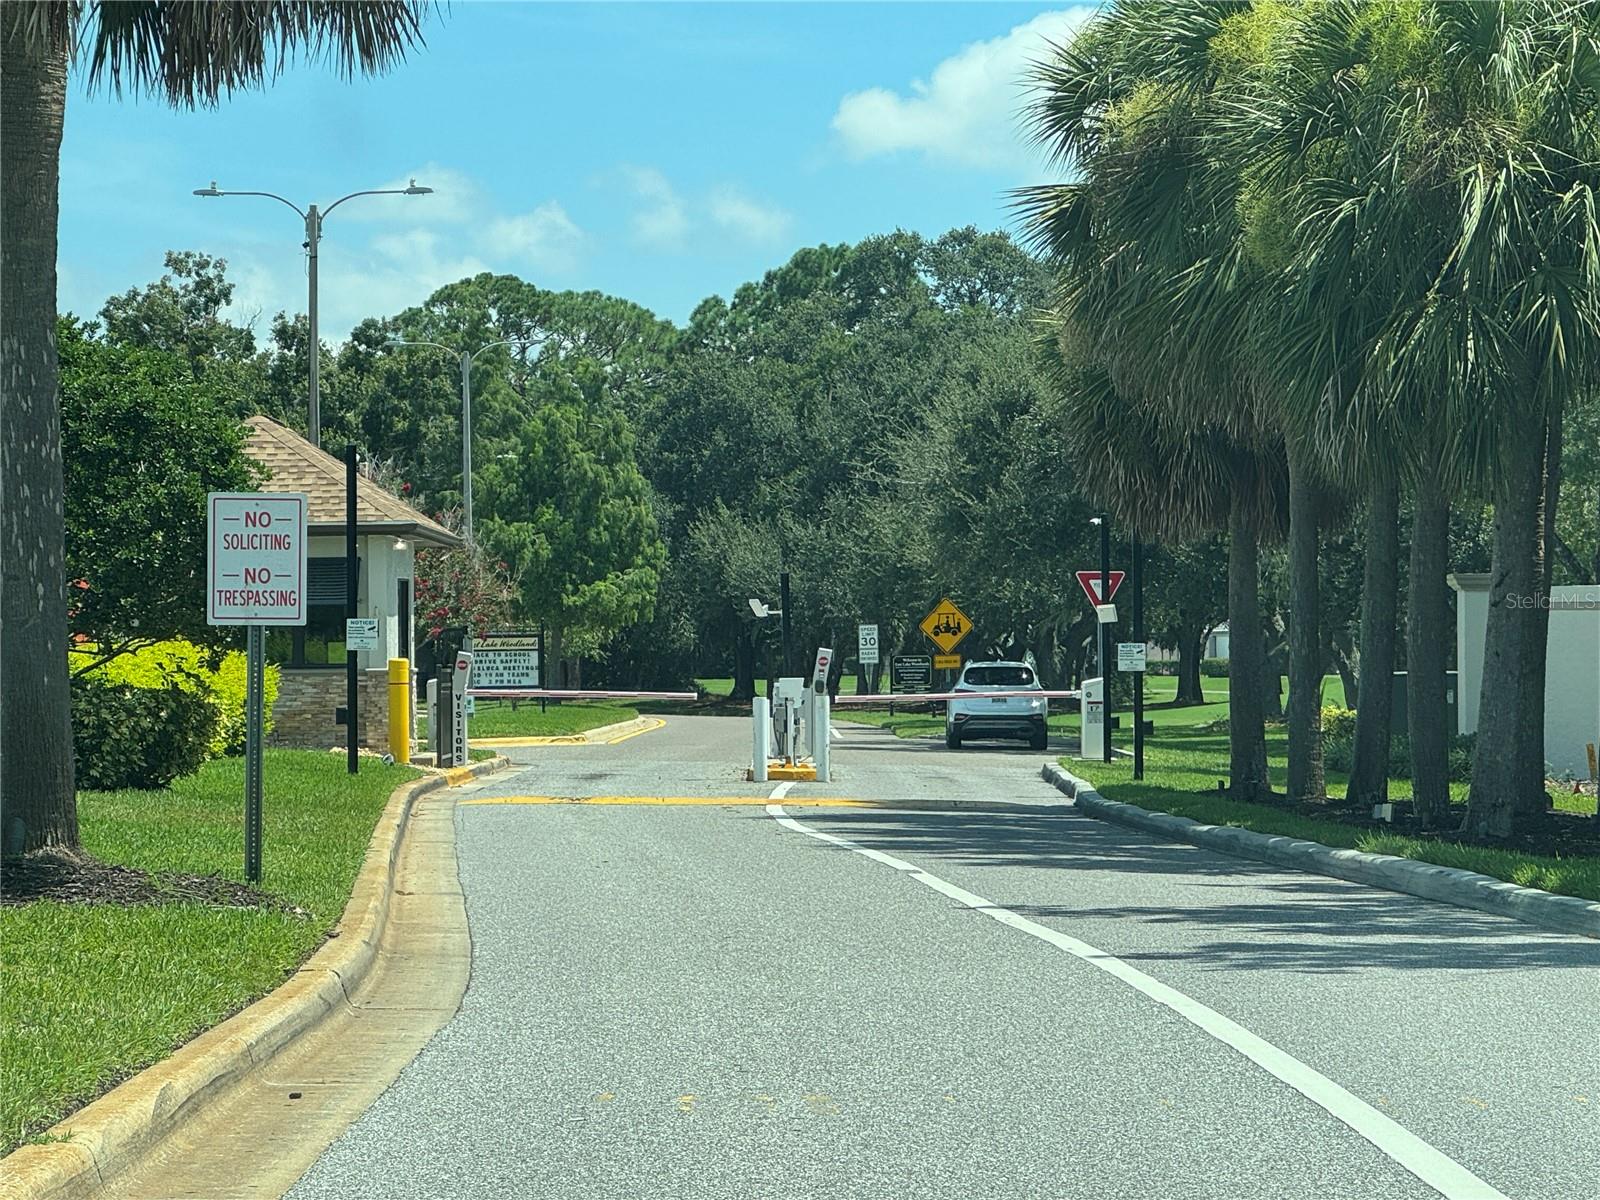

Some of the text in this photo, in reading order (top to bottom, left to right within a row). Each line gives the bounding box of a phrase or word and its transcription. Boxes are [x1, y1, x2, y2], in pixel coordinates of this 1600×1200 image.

[245, 511, 272, 528] NO
[223, 533, 291, 550] SOLICITING
[244, 567, 271, 584] NO
[216, 589, 297, 607] TRESPASSING
[481, 639, 498, 648] Lake
[860, 637, 876, 646] 30
